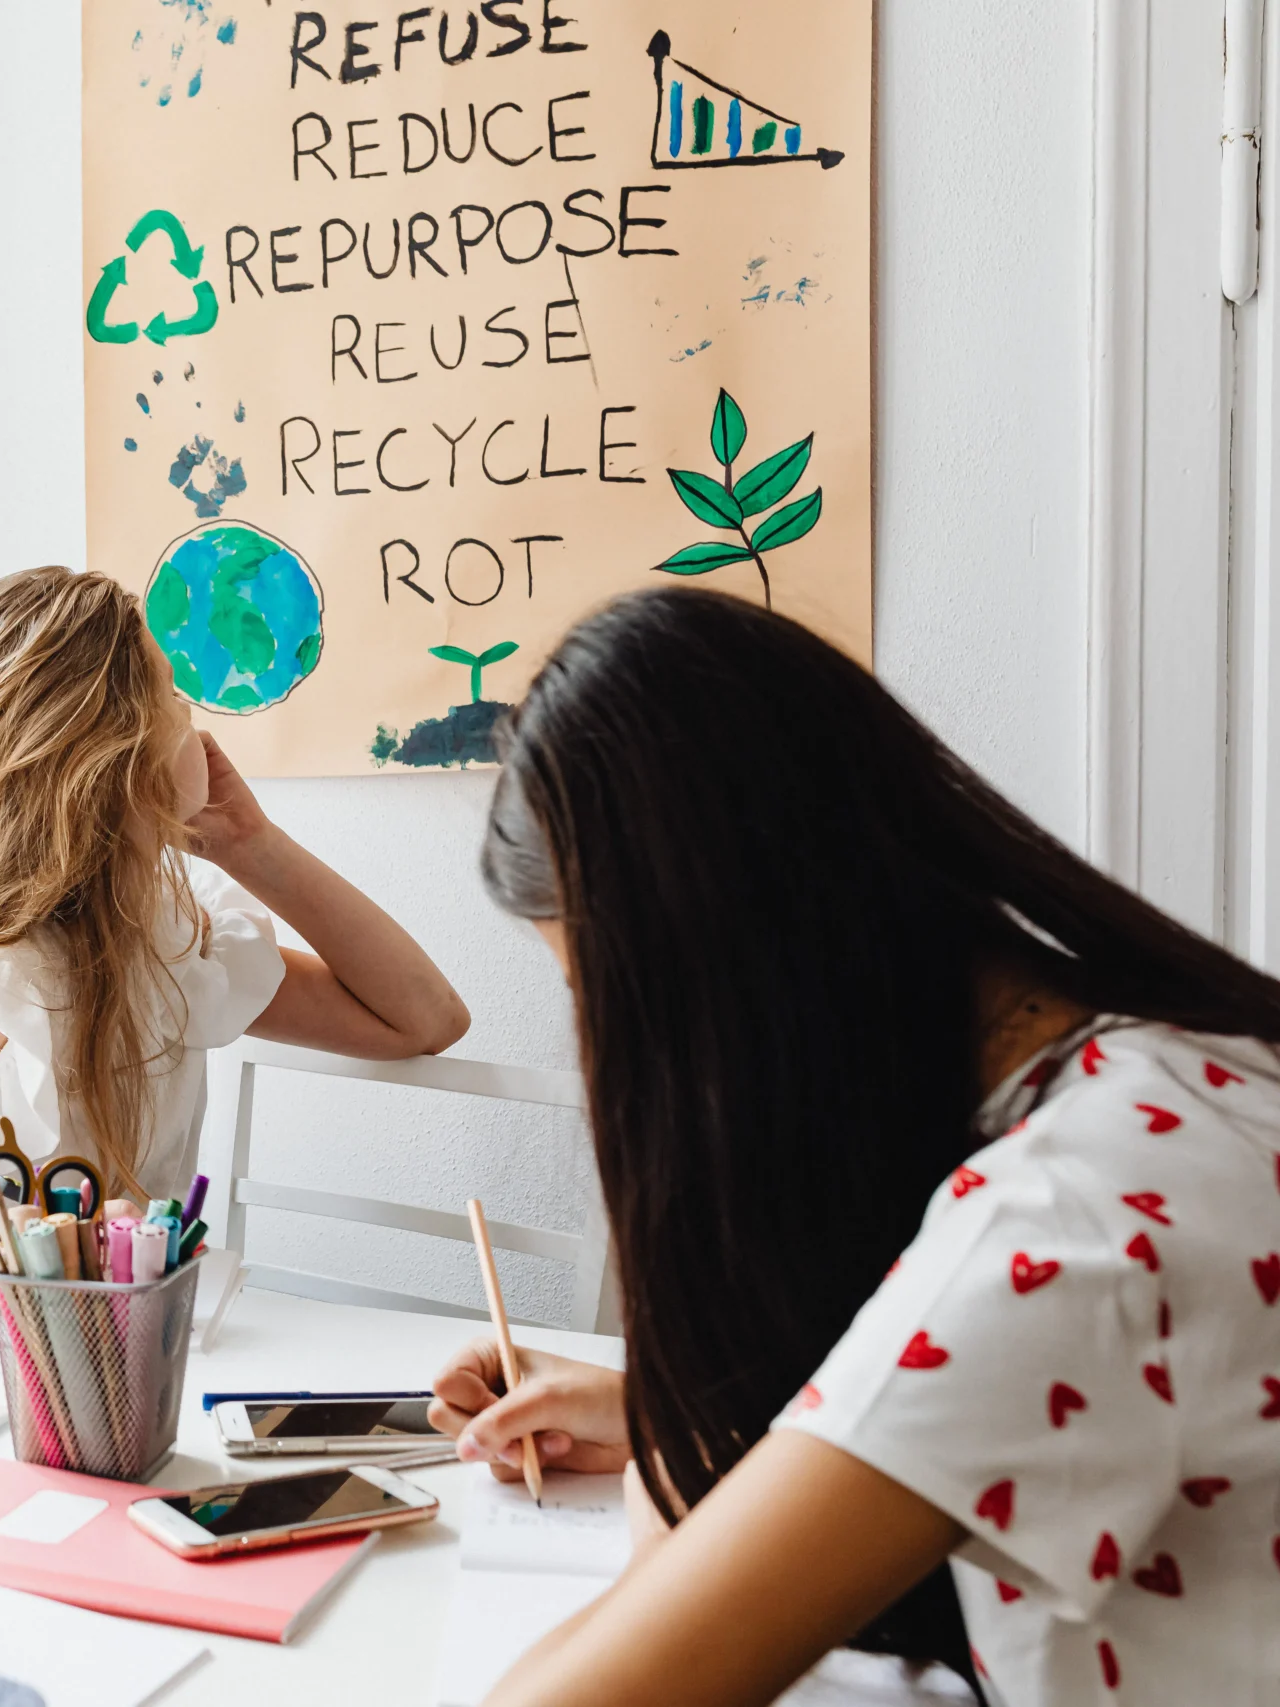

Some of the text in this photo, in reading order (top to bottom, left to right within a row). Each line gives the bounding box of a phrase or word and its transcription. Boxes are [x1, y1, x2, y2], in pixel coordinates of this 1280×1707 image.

[289, 0, 588, 88] REFUSE
[291, 91, 597, 181] REDUCE
[225, 184, 679, 303] REPURPOSE
[330, 298, 592, 384] REUSE
[279, 405, 647, 498] RECYCLE
[379, 534, 565, 607] ROT
